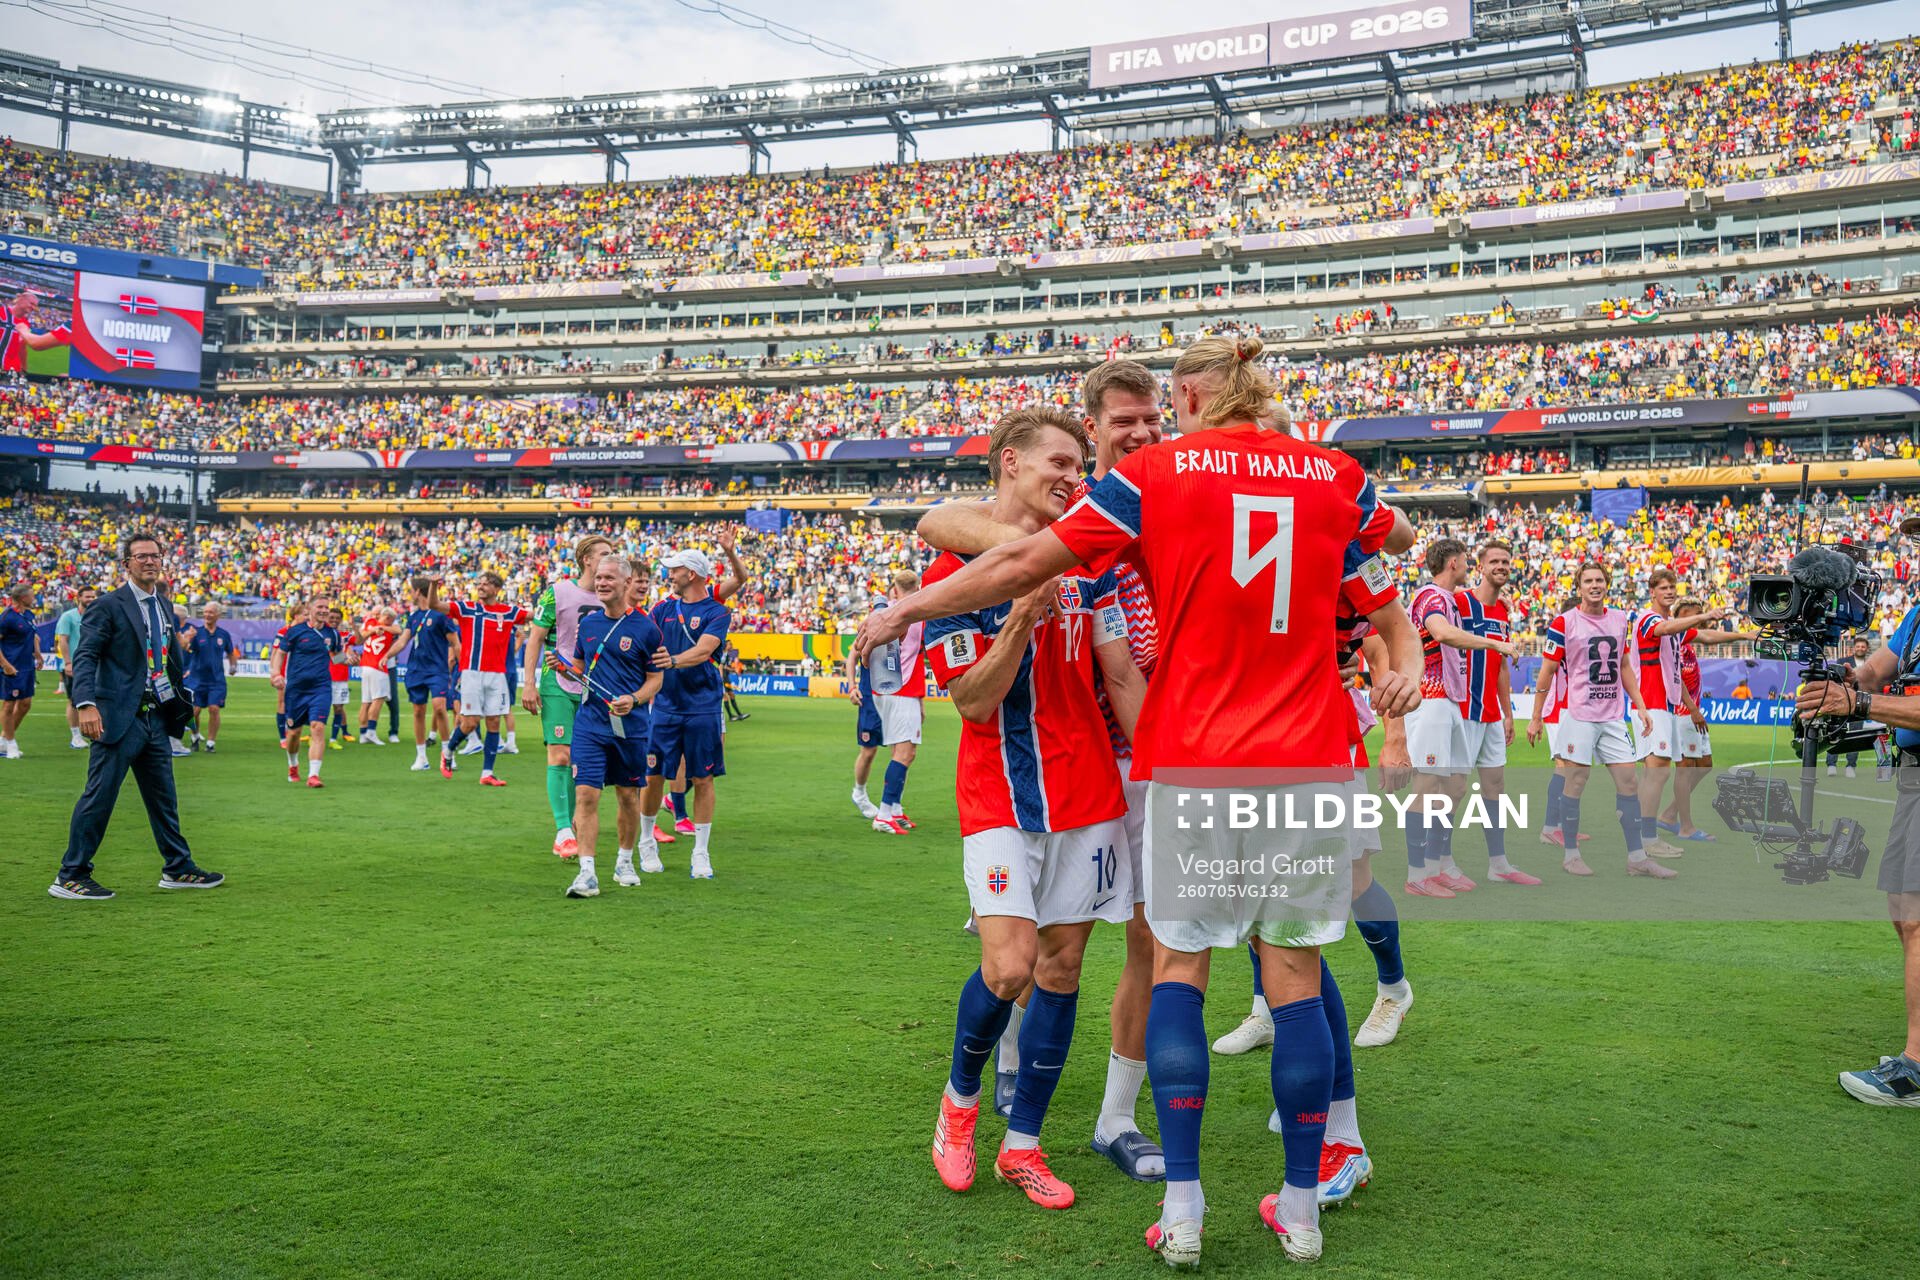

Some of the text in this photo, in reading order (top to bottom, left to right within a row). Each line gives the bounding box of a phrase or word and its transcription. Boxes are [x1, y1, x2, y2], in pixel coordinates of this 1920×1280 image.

[1108, 6, 1449, 72] FIFA WORLD CUP 2026
[10, 243, 78, 265] 2026
[103, 319, 172, 344] NORWAY
[1540, 407, 1683, 425] FIFA WORLD CUP 2026
[1769, 400, 1808, 414] NORWAY
[1449, 417, 1484, 430] NORWAY
[132, 450, 154, 460] FIFA
[550, 452, 567, 461] FIFA
[567, 451, 597, 461] WORLD
[1175, 449, 1337, 482] BRAUT HAALAND
[1230, 493, 1295, 634] 9
[1059, 614, 1083, 662] 10
[738, 676, 768, 695] World
[773, 680, 796, 691] FIFA
[1598, 672, 1612, 682] FIFA
[1589, 691, 1618, 700] 2026
[1710, 700, 1761, 725] World
[1770, 706, 1794, 719] FIF
[1092, 844, 1117, 893] 10
